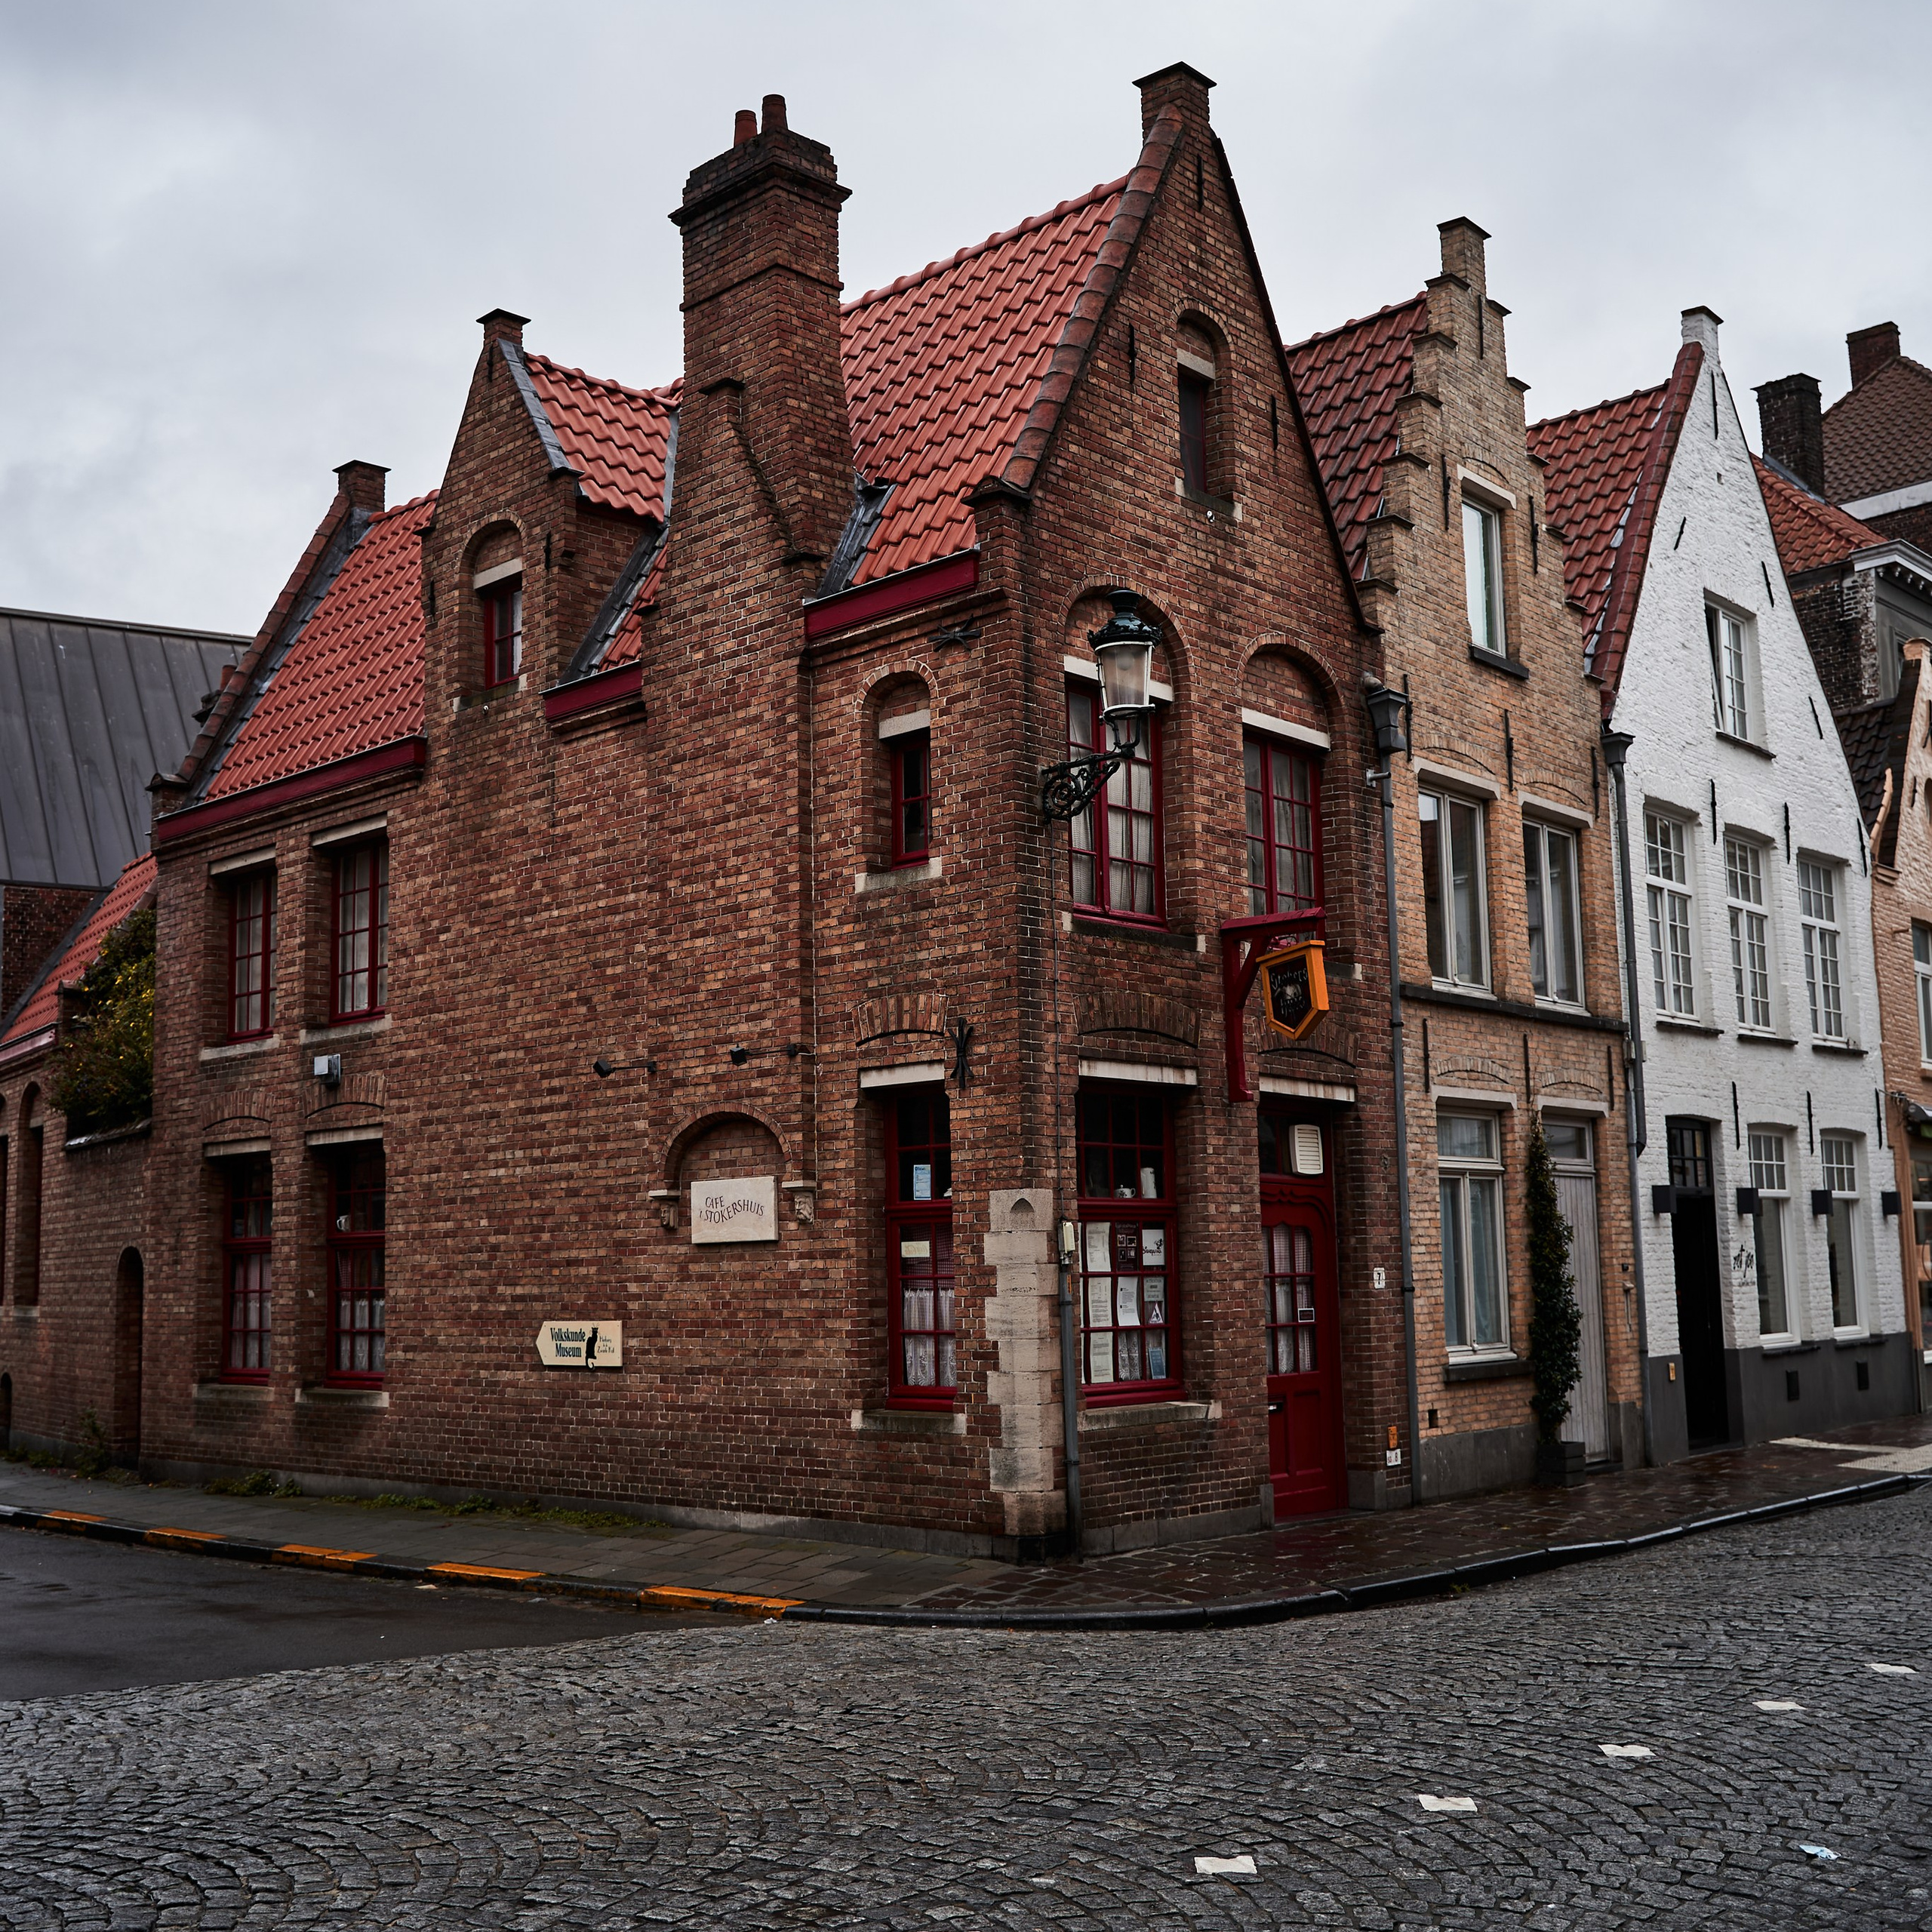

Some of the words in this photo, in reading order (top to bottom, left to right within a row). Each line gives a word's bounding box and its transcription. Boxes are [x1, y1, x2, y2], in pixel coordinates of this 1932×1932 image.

[705, 1195, 725, 1209] CAFE
[704, 1199, 764, 1223] STOKERSHUIS
[1377, 1272, 1381, 1285] 7
[550, 1327, 586, 1342] Volkskunde
[555, 1343, 582, 1357] Museum
